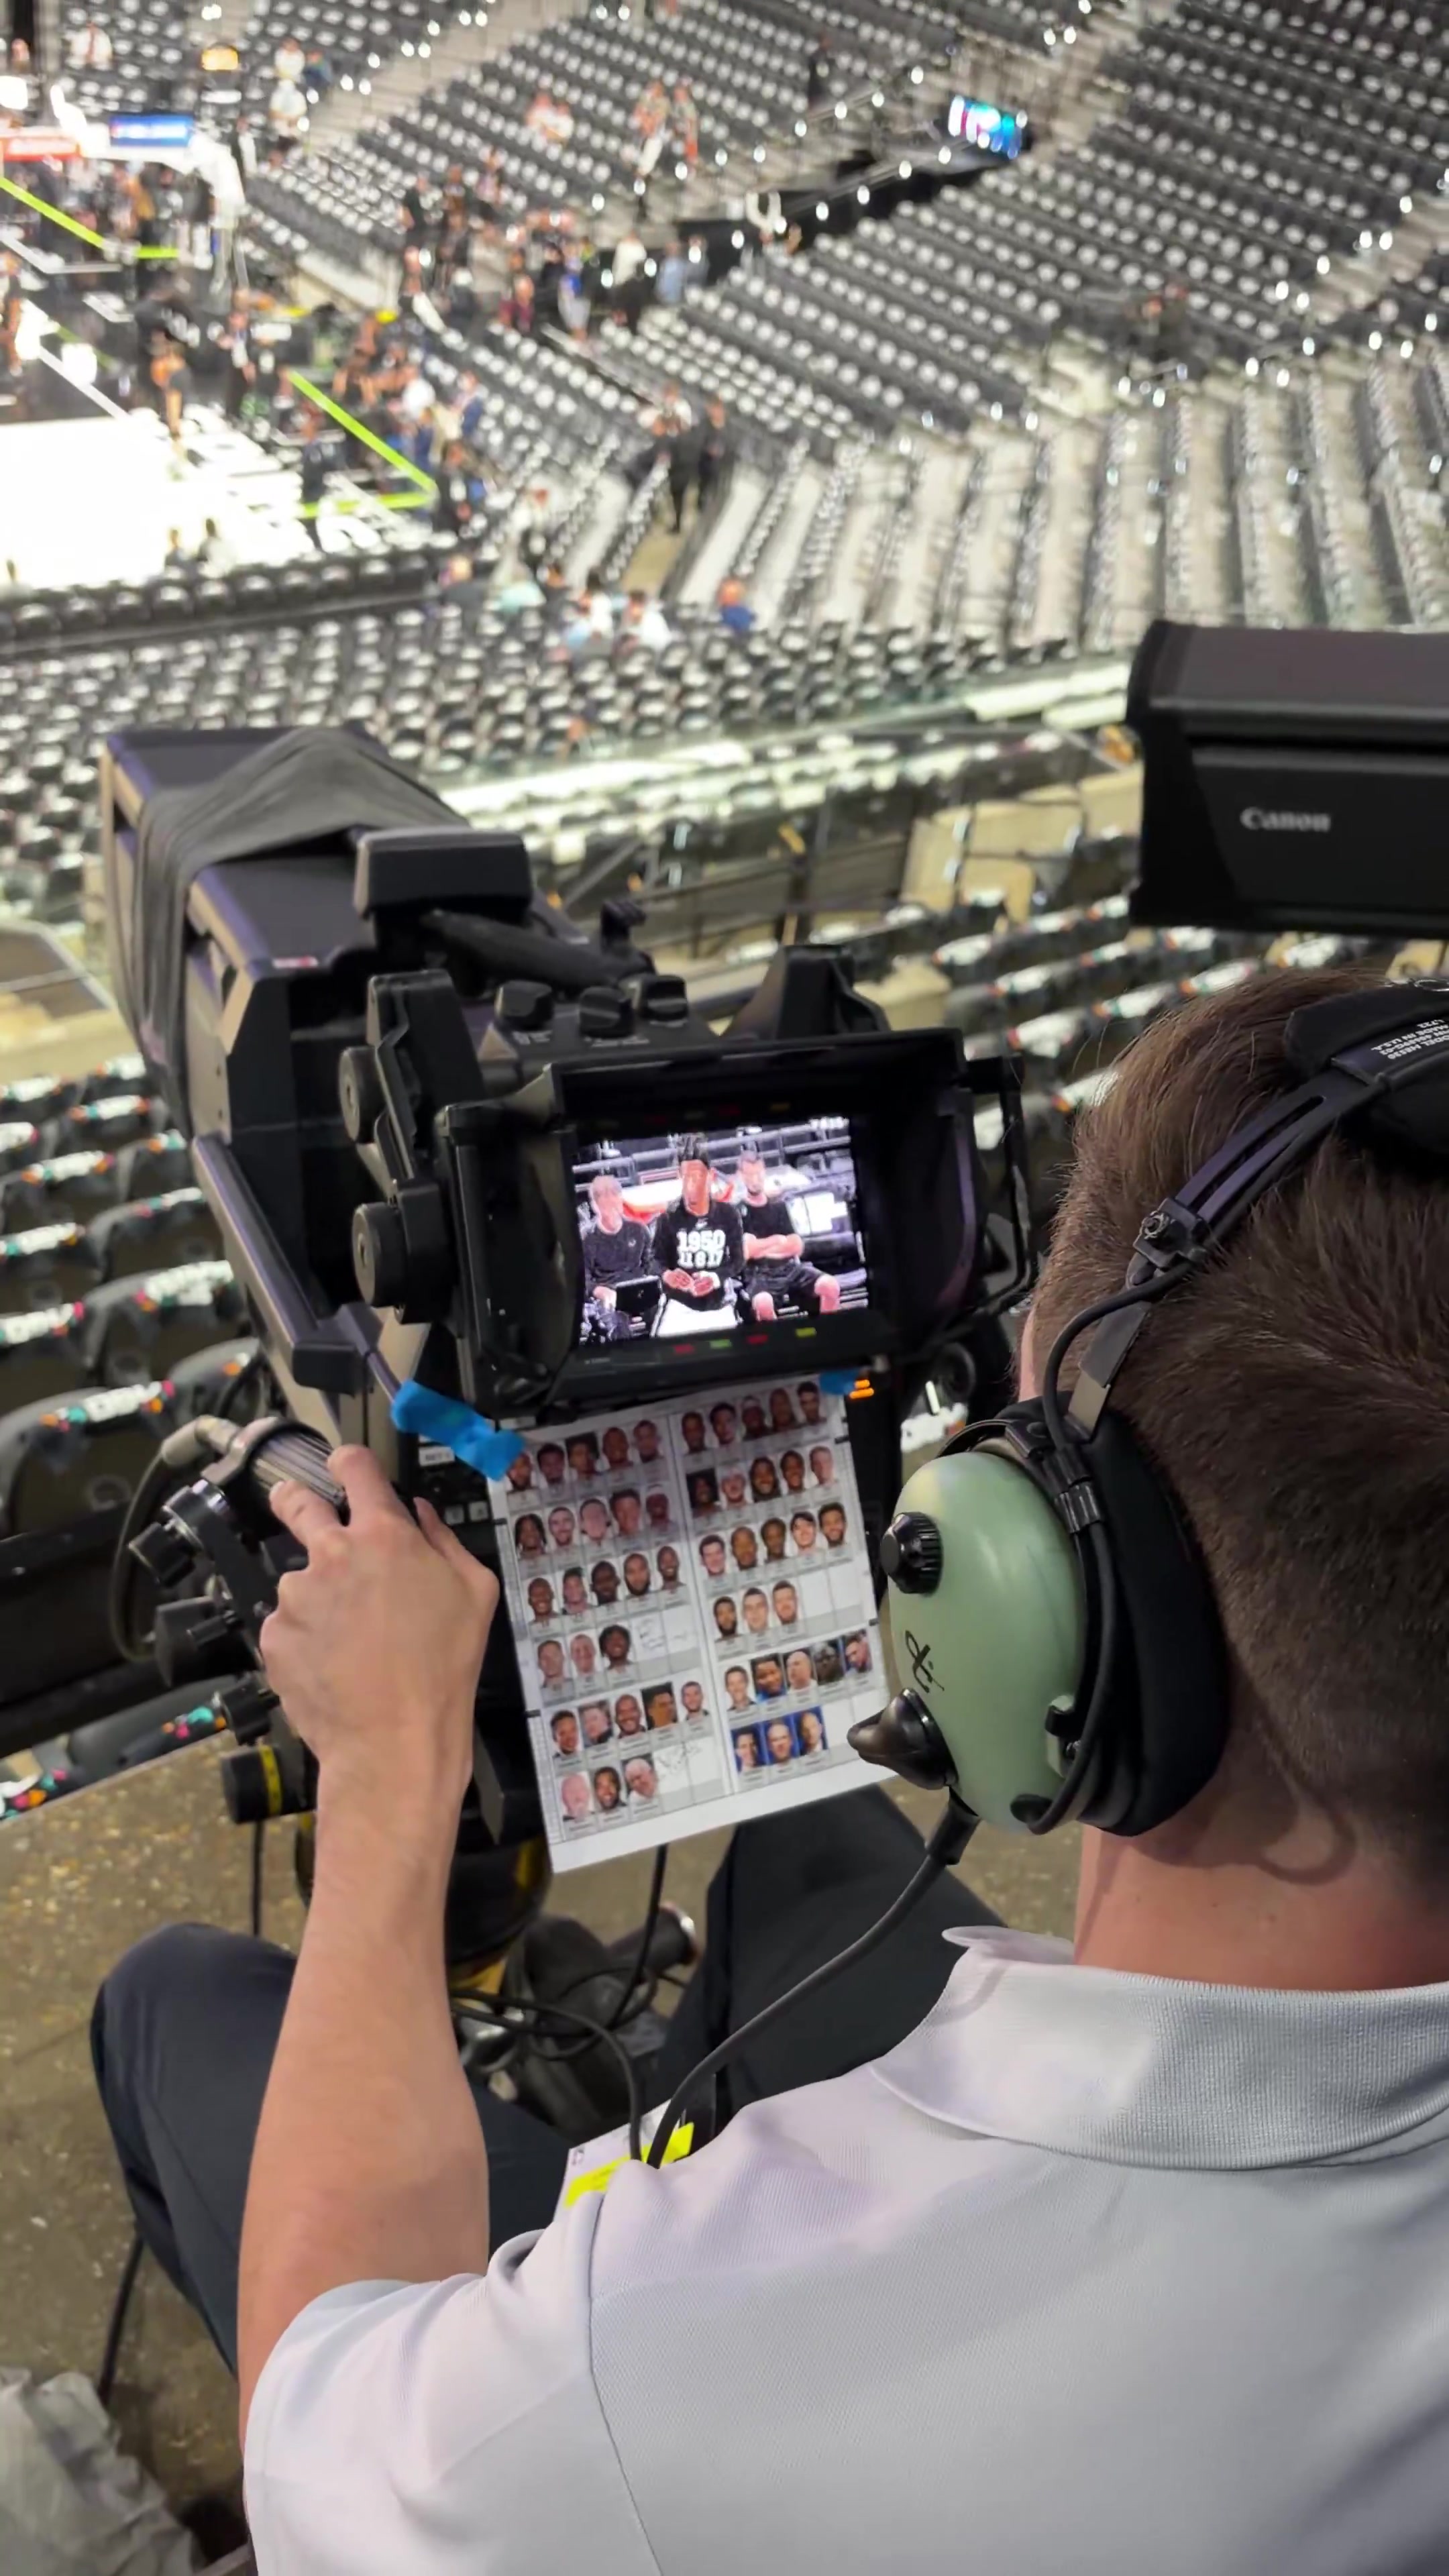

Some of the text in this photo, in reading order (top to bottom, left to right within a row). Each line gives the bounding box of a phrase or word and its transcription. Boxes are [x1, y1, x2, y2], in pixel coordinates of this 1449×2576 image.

[1240, 806, 1331, 832] Canon
[1415, 1024, 1448, 1036] MADE
[1419, 1034, 1449, 1046] ODEL
[676, 1229, 726, 1252] 1950
